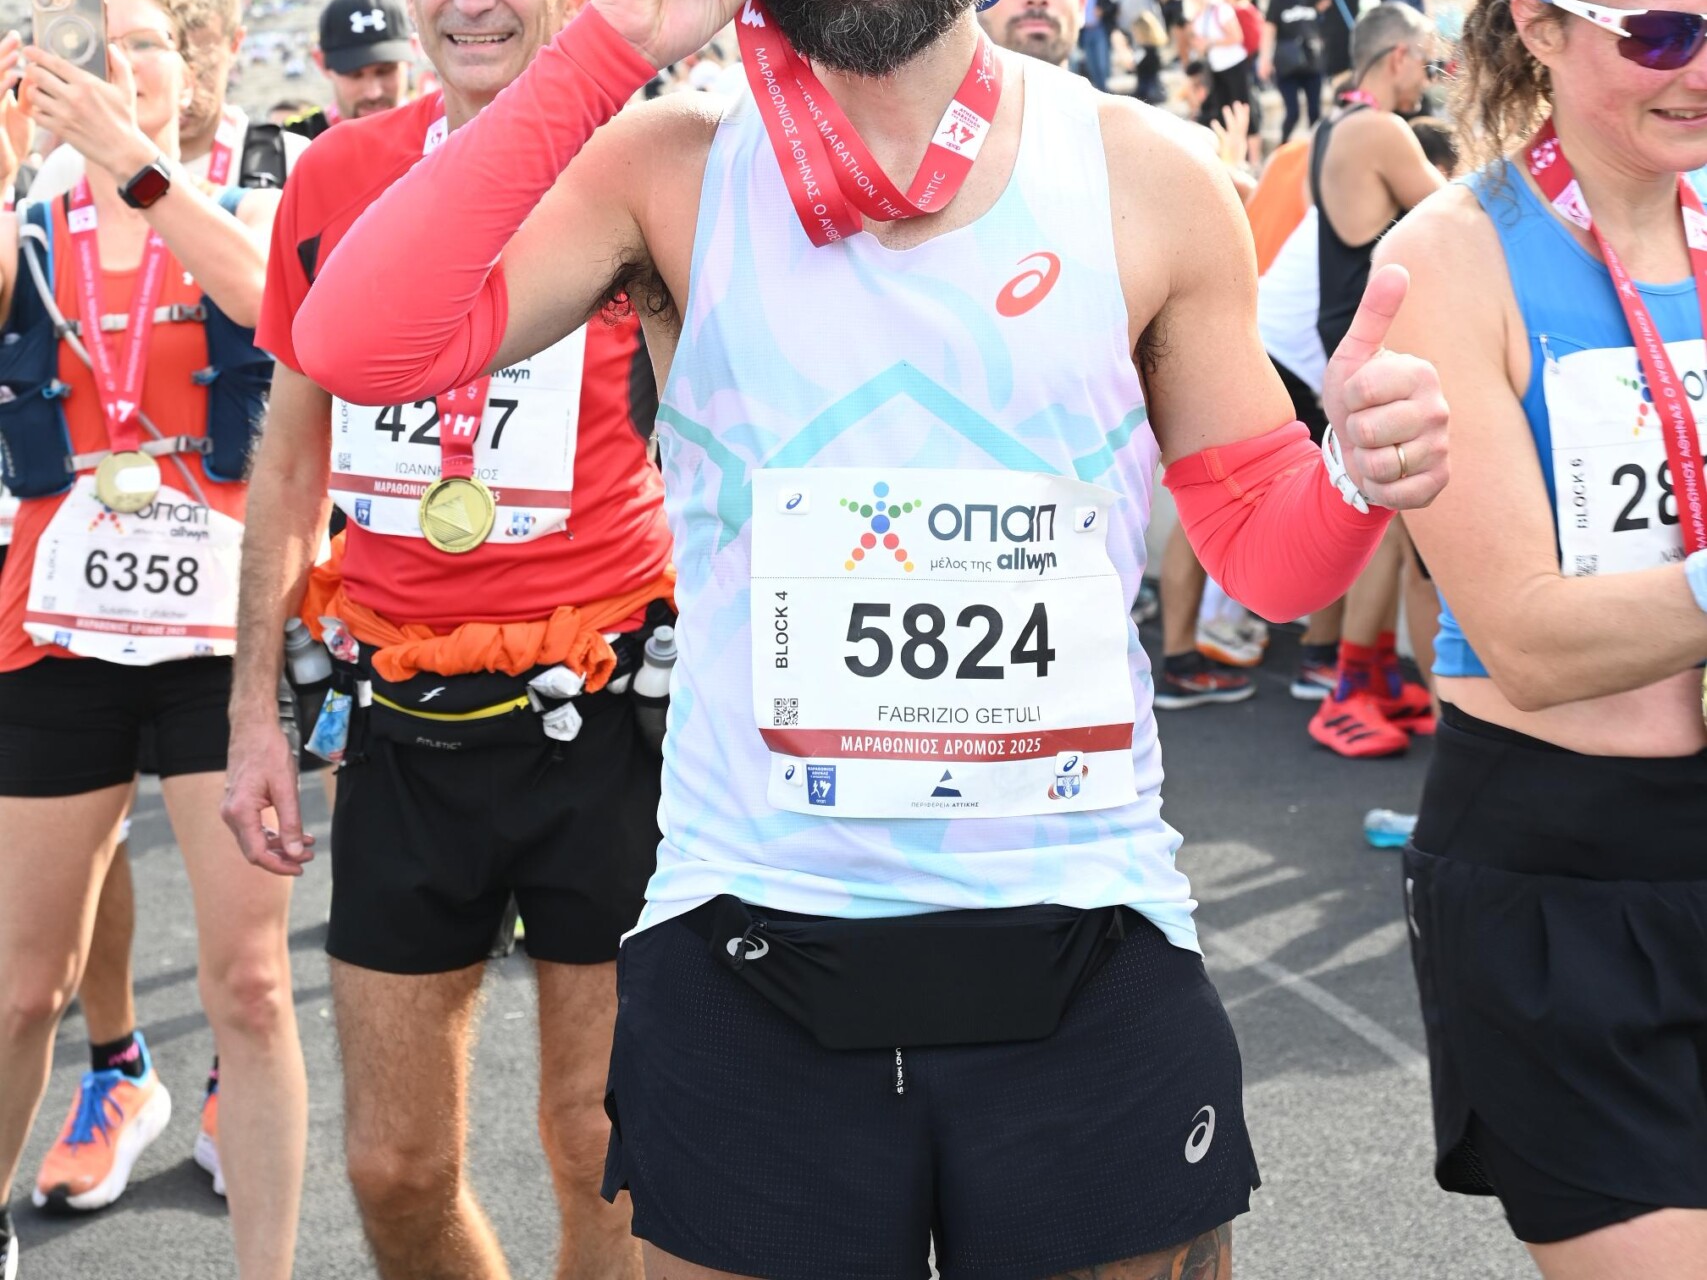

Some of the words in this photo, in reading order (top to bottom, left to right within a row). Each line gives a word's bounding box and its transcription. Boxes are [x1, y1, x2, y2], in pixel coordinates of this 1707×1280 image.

[755, 48, 798, 137] ΜΑΡΑΘΩΝΙΟΣ
[819, 219, 841, 242] ΑΥΘΕ
[818, 120, 878, 198] MARATHON.
[878, 198, 902, 216] THE
[917, 171, 946, 208] HENTIC
[375, 397, 519, 449] 427
[374, 481, 427, 495] ΜΑΡΑΘΩΝΙΟ
[1572, 473, 1588, 529] BLOCK
[1611, 457, 1707, 532] 28
[85, 549, 199, 596] 6358
[930, 556, 968, 571] μέλος
[970, 560, 992, 572] της
[997, 547, 1057, 575] allwyn
[775, 590, 788, 601] 4
[775, 607, 789, 669] BLOCK
[844, 602, 1056, 680] 5824
[878, 706, 969, 723] FABRIZIO
[975, 706, 1041, 724] GETULI
[841, 735, 938, 755] ΜΑΡΑΘΩΝΙΟΣ
[944, 738, 1006, 756] ΔΡΟΜΟΣ
[1010, 737, 1041, 754] 2025
